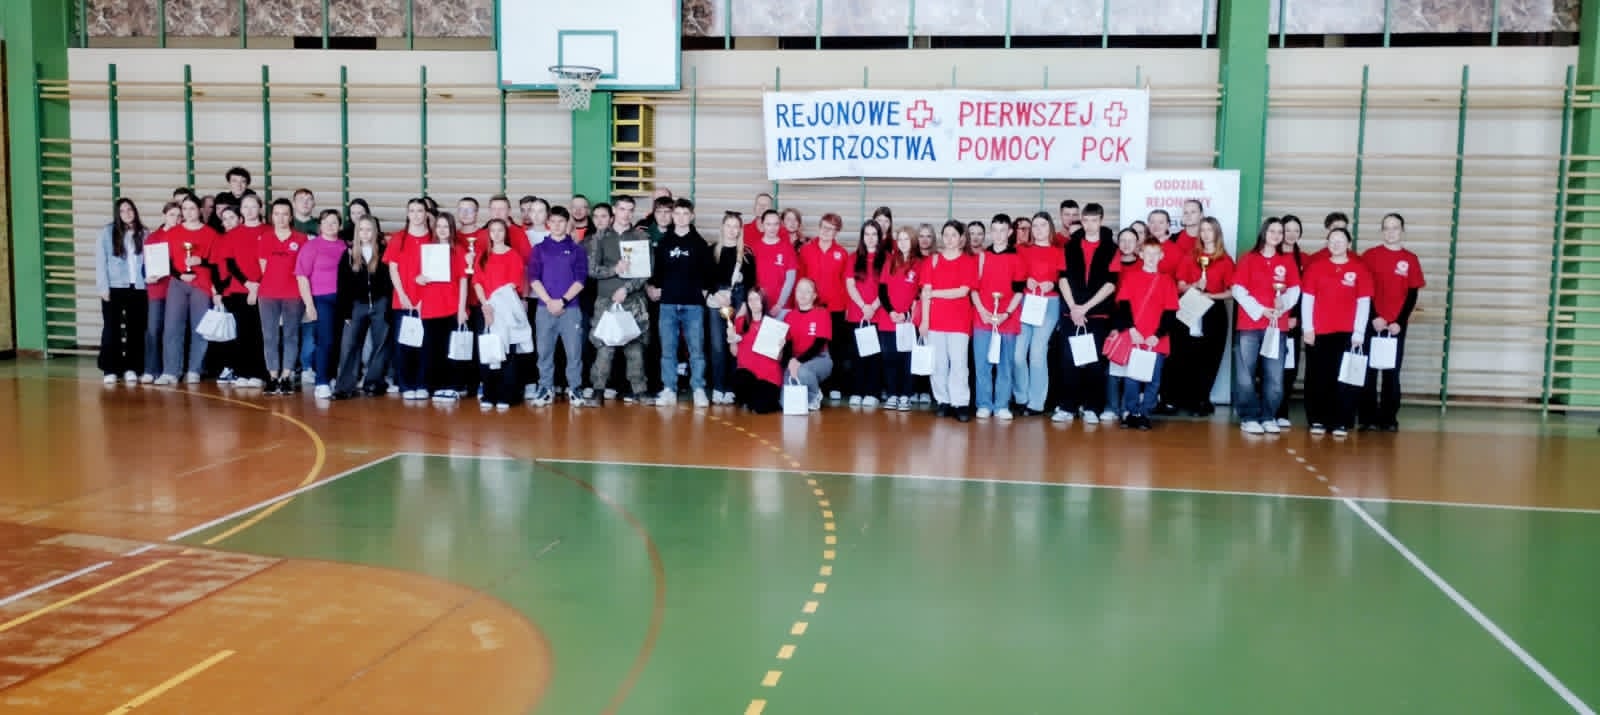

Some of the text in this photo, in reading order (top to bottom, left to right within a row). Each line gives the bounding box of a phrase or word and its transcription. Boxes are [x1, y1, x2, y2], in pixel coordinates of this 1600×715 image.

[775, 99, 1094, 129] REJONOWE PIERWSZEJ
[776, 133, 1131, 163] MISTRZOSTWA POMOCY PCK
[1145, 197, 1212, 208] REJONY
